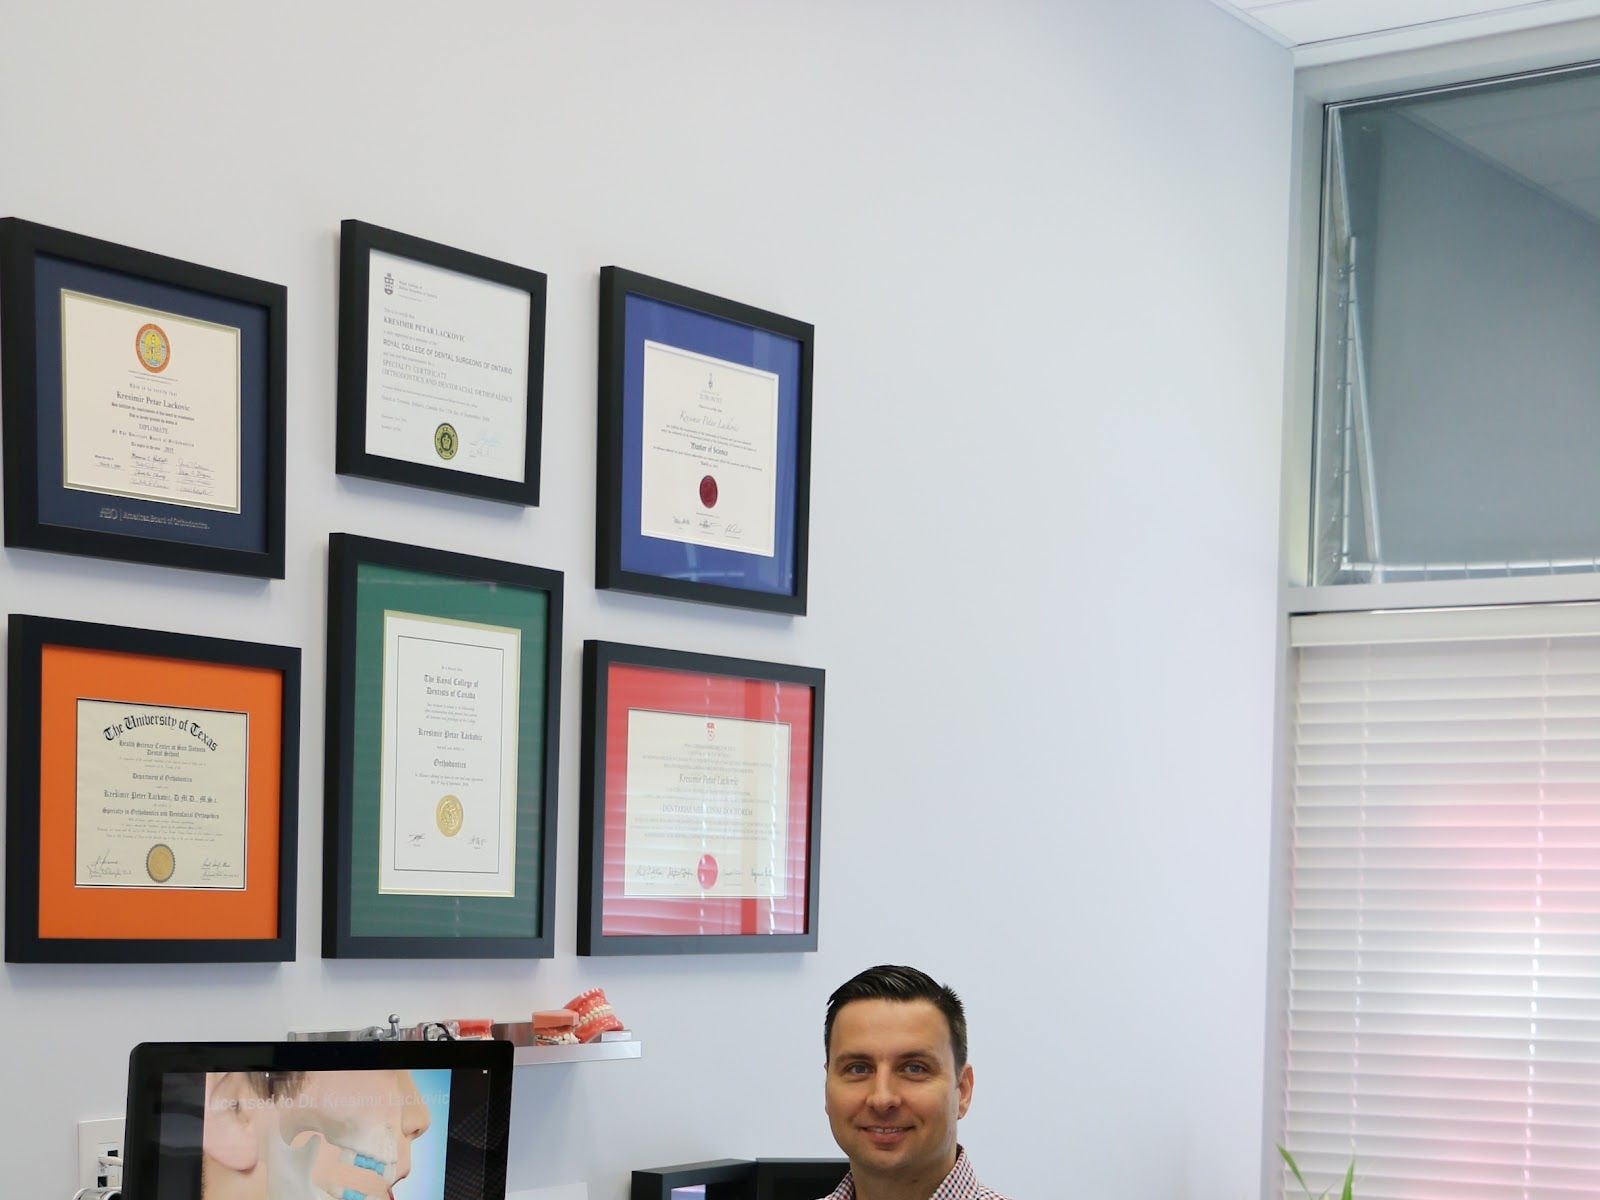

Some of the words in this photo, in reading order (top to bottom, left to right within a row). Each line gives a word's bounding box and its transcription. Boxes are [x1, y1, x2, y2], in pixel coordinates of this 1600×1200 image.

[401, 343, 425, 355] COLLEGE
[434, 351, 454, 362] DENTAL
[454, 678, 473, 688] College
[103, 724, 124, 741] The
[124, 714, 177, 730] University
[179, 720, 189, 731] of
[190, 722, 218, 751] Texas
